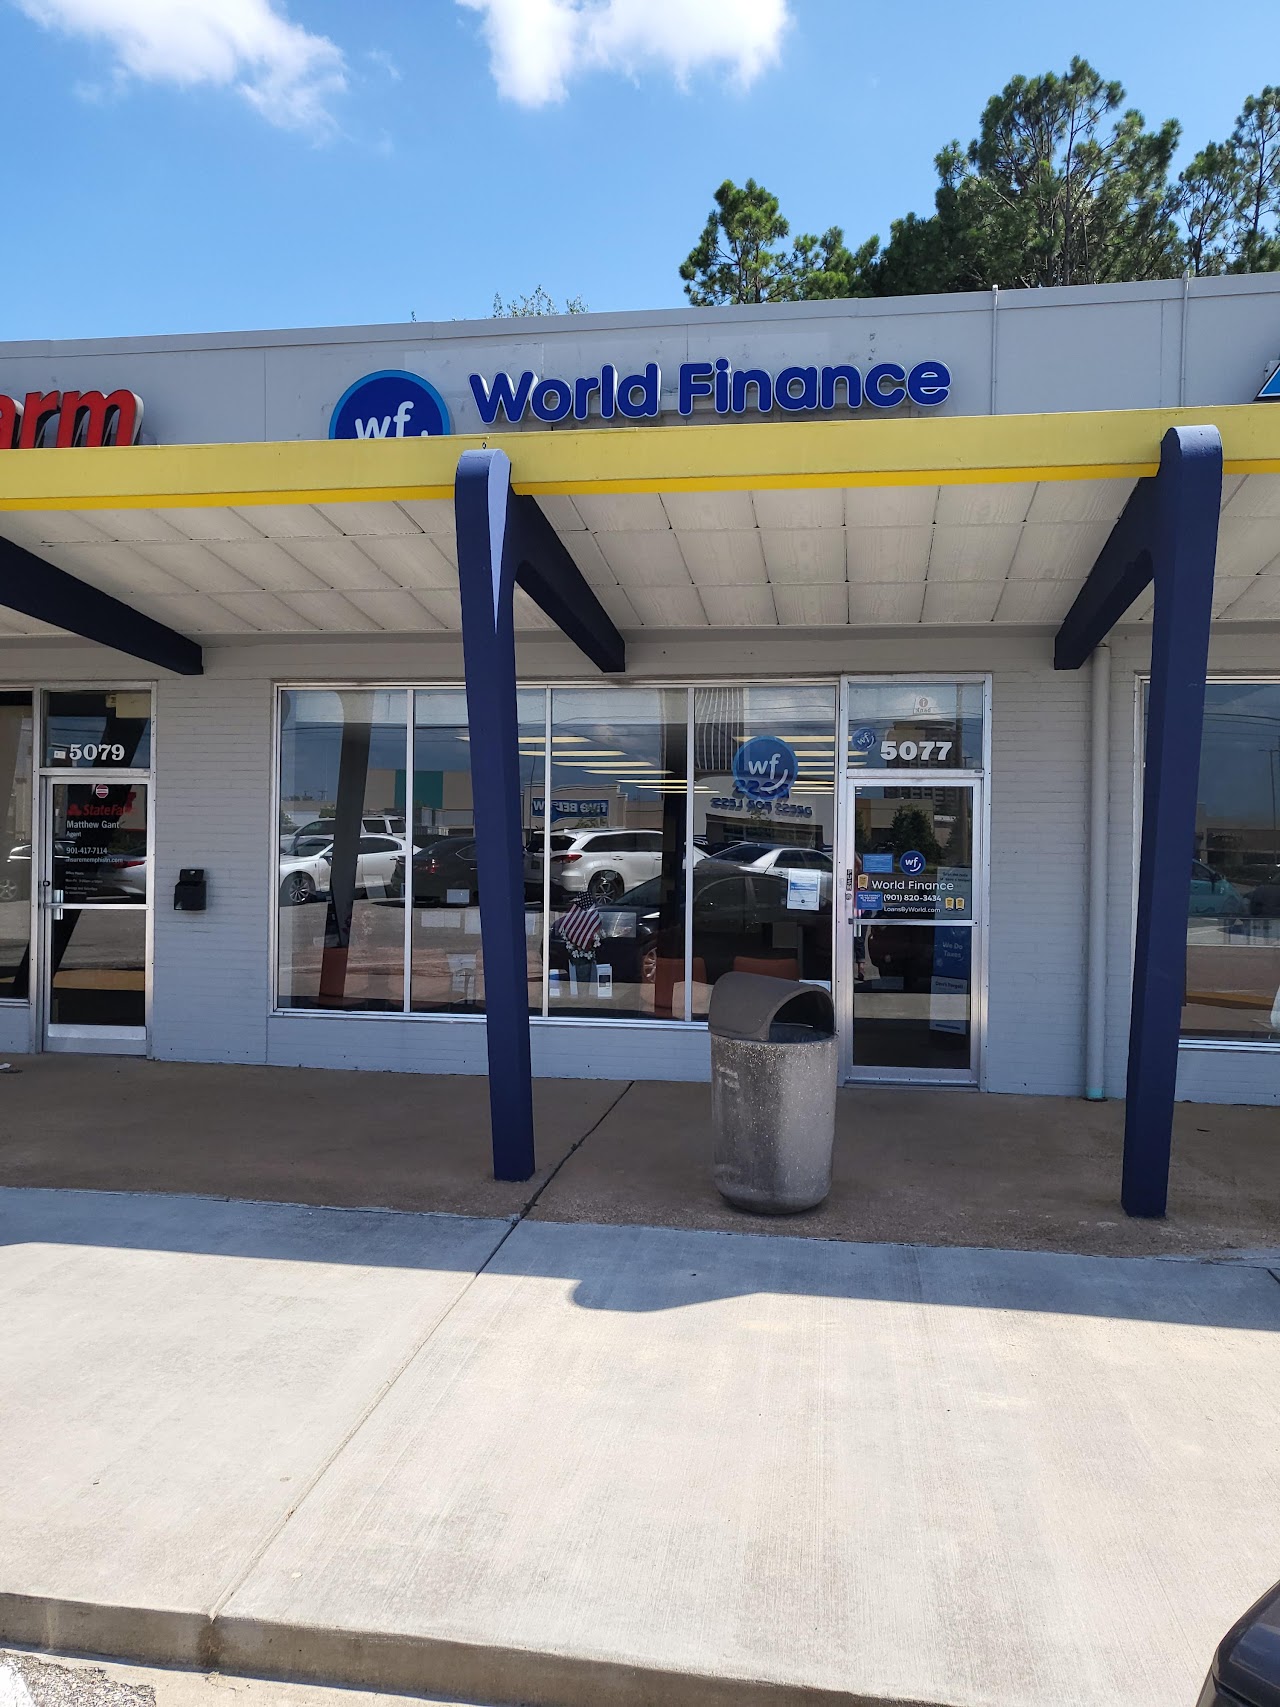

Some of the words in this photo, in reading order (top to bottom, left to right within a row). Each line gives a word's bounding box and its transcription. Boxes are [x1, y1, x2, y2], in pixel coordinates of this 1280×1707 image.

[468, 361, 659, 425] World
[677, 357, 951, 416] Finance
[69, 743, 126, 760] 5079
[880, 741, 952, 760] 5077
[748, 753, 781, 780] wf
[66, 820, 99, 829] Matthew
[101, 820, 120, 829] Gant
[66, 846, 108, 854] 901-417-7114
[905, 857, 919, 868] wf
[871, 880, 905, 890] World
[908, 880, 954, 891] Finance
[883, 894, 903, 903] (901)
[904, 894, 942, 902] 820-3434
[883, 906, 941, 914] LoansByWorld.com
[942, 941, 953, 949] We
[953, 942, 963, 950] Do
